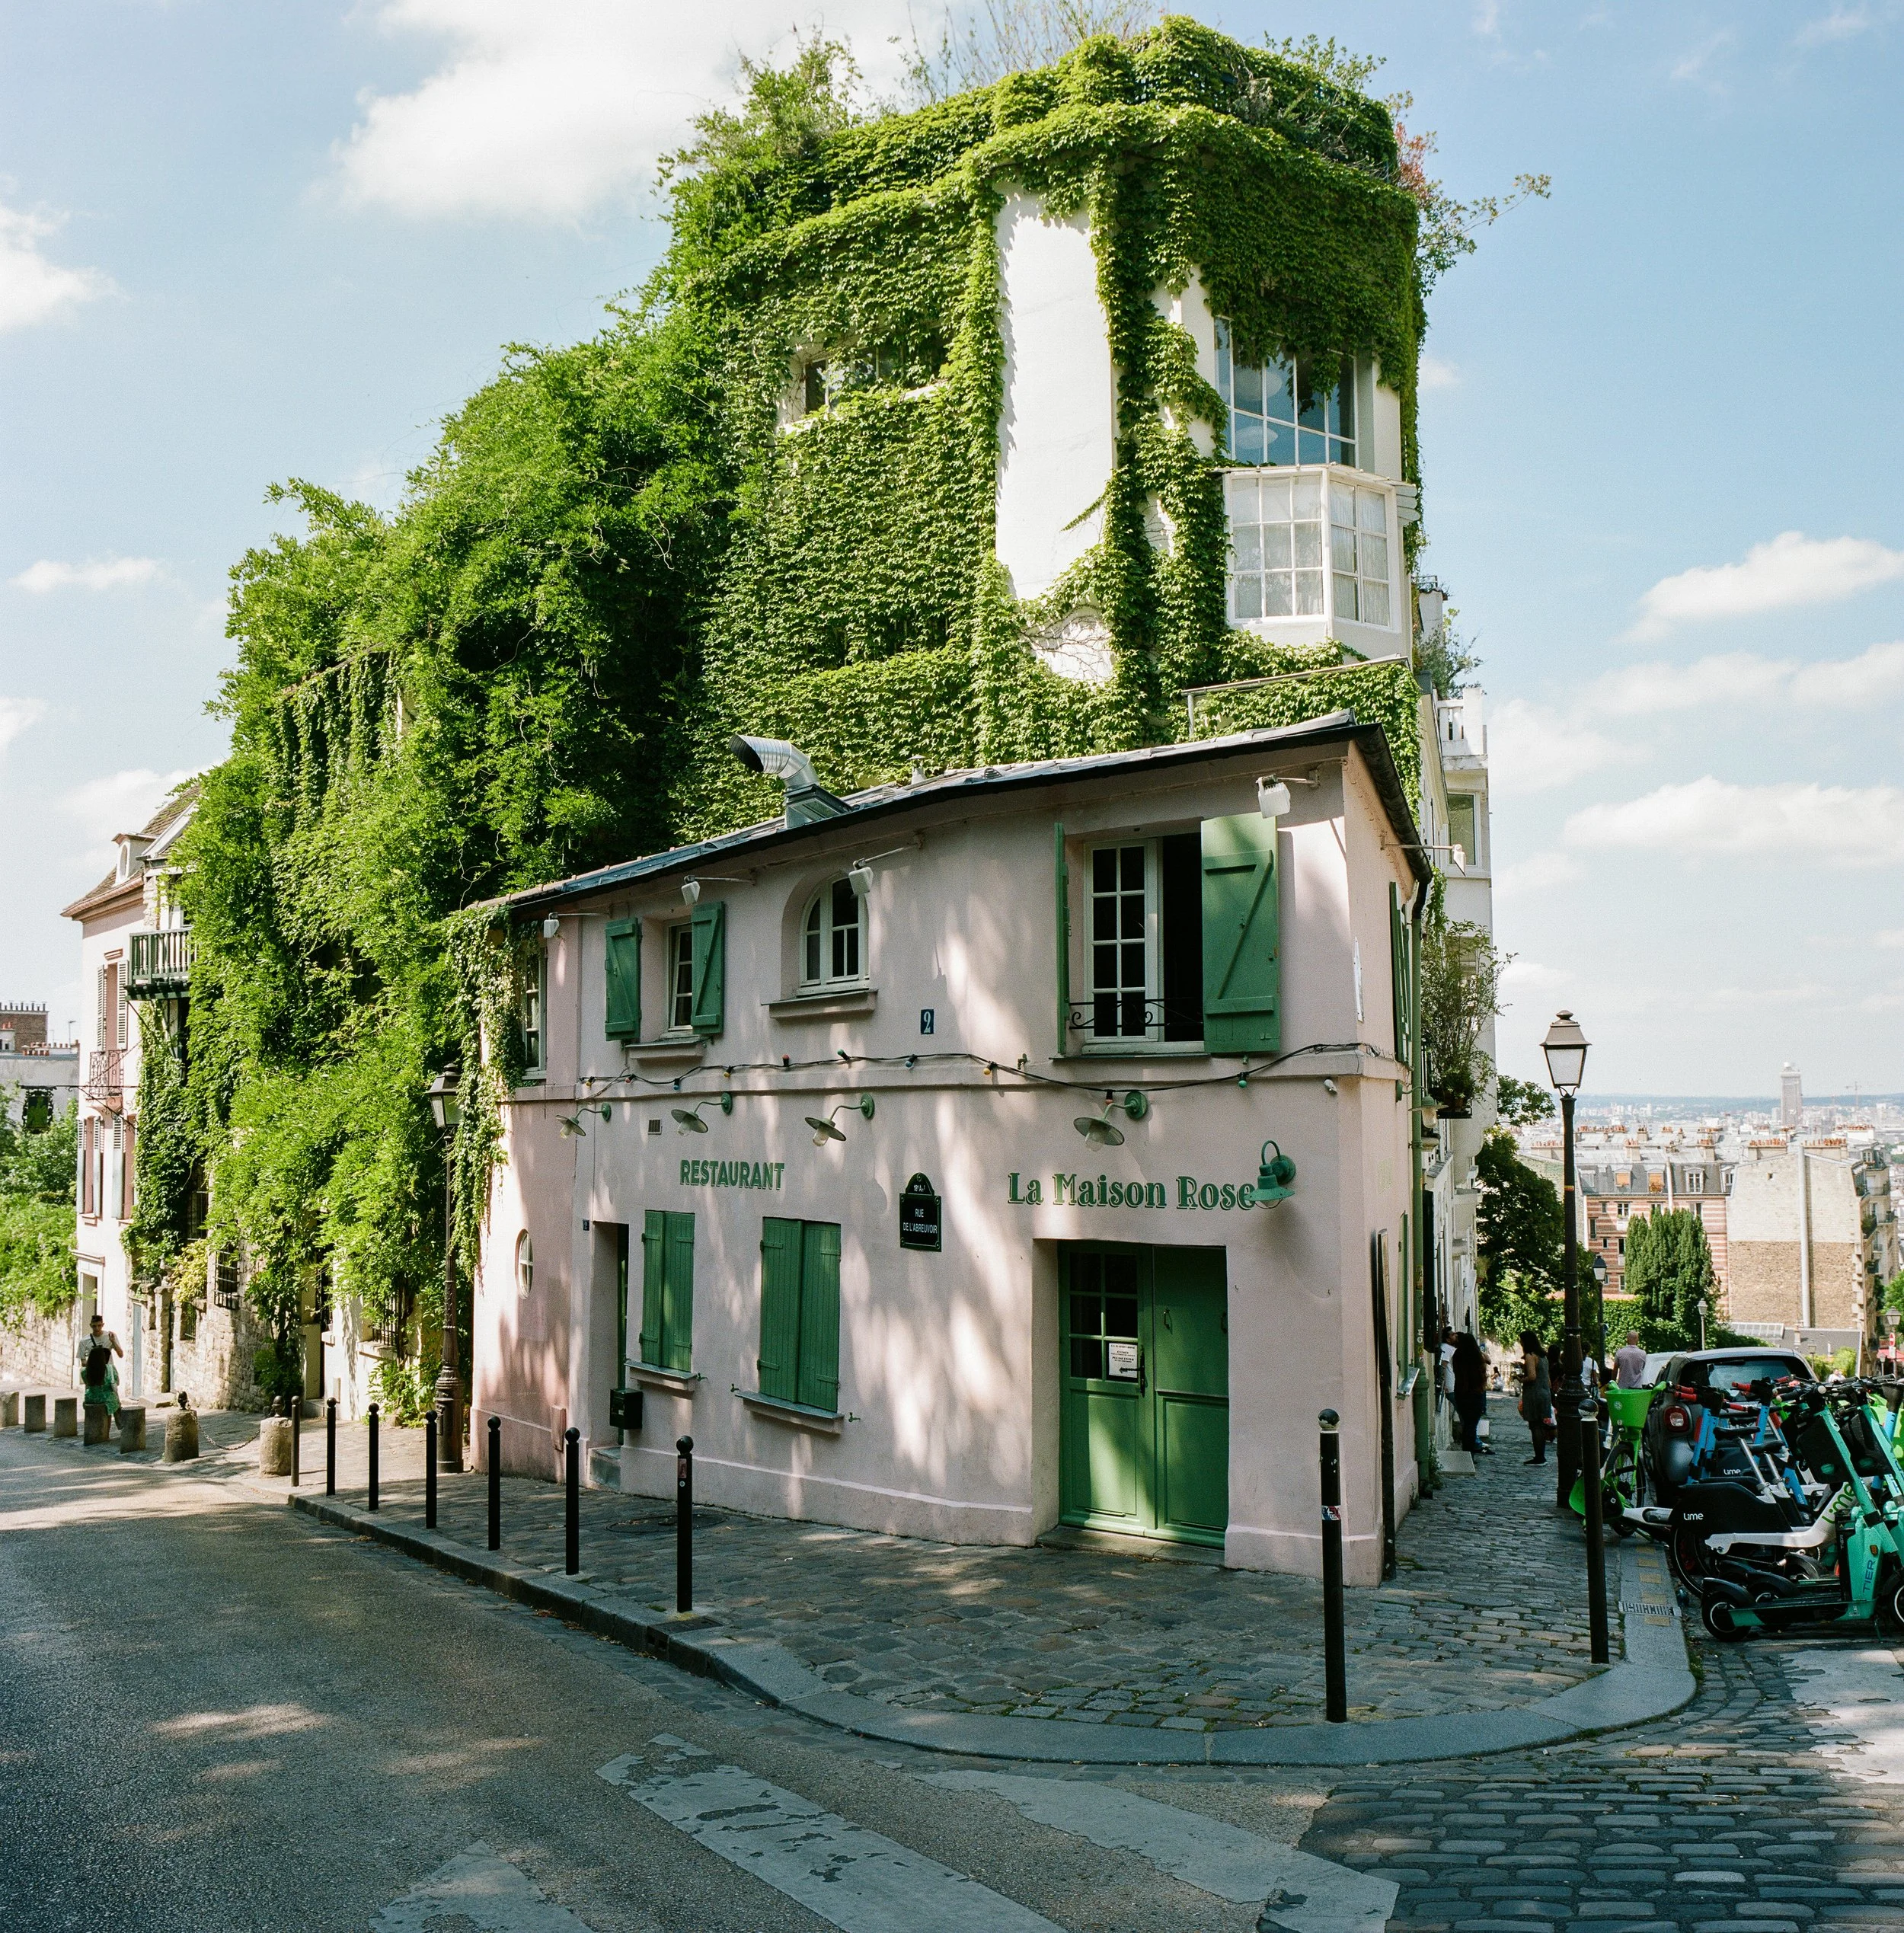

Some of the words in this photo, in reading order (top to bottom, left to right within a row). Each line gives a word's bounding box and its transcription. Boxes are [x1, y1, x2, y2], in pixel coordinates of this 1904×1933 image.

[923, 1011, 931, 1034] 2
[680, 1159, 785, 1190] RESTAURANT
[1008, 1172, 1044, 1205] La
[1052, 1173, 1167, 1209] Maison
[1176, 1175, 1256, 1211] Rose
[915, 1209, 925, 1218] RUE
[902, 1222, 909, 1232] DE
[909, 1222, 938, 1234] L'ABREUVOIR
[1683, 1513, 1704, 1521] Lime
[1863, 1560, 1876, 1593] TIER
